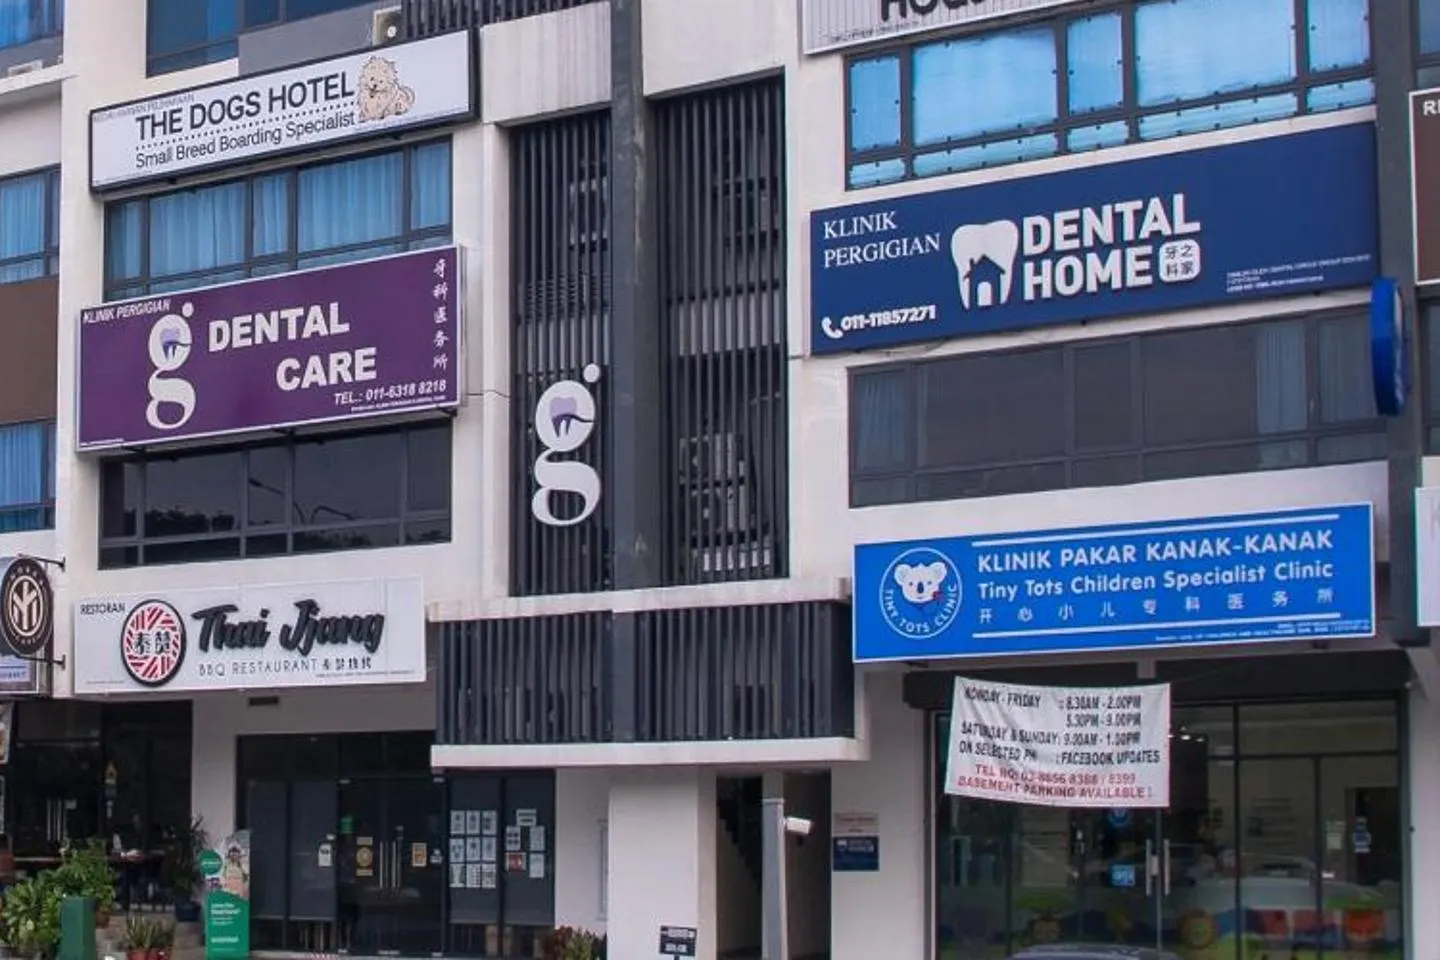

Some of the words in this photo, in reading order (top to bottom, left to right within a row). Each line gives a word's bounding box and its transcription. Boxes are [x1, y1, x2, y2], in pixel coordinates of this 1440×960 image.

[136, 108, 183, 140] THE
[189, 91, 261, 130] DOGS
[269, 71, 355, 112] HOTEL
[136, 142, 173, 169] Small
[176, 133, 217, 160] Breed
[219, 125, 283, 154] Boarding
[286, 110, 356, 140] Specialist
[824, 211, 896, 240] KLINIK
[1023, 193, 1201, 257] DENTAL
[824, 233, 941, 269] PERGIGIAN
[1024, 244, 1154, 301] HOME
[83, 307, 115, 325] KLINIK
[116, 298, 172, 320] PERGIGIAN
[208, 302, 351, 352] DENTAL
[276, 347, 378, 391] CARE
[978, 549, 1052, 573] KLINIK
[1061, 544, 1137, 568] PAKAR
[1146, 529, 1334, 561] KANAK-KANAK
[978, 582, 1018, 602] Tiny
[1025, 578, 1063, 597] Tots
[1071, 572, 1156, 594] Children
[1163, 566, 1266, 592] Specialist
[1274, 560, 1334, 581] Clinic
[191, 604, 271, 653] Thai
[900, 618, 930, 633] TOTS
[934, 583, 958, 627] CLINIC
[232, 657, 318, 675] RESTAURANT
[1007, 692, 1041, 709] FRIDAY
[960, 740, 973, 753] ON
[975, 742, 1021, 761] SELECTED
[1062, 751, 1114, 766] FACEBOOK
[1116, 750, 1161, 764] UPDATES
[976, 764, 996, 777] TEL
[958, 776, 1020, 793] BASEMENT
[1023, 783, 1077, 798] PARKING
[1079, 785, 1146, 799] AVAILABLE
